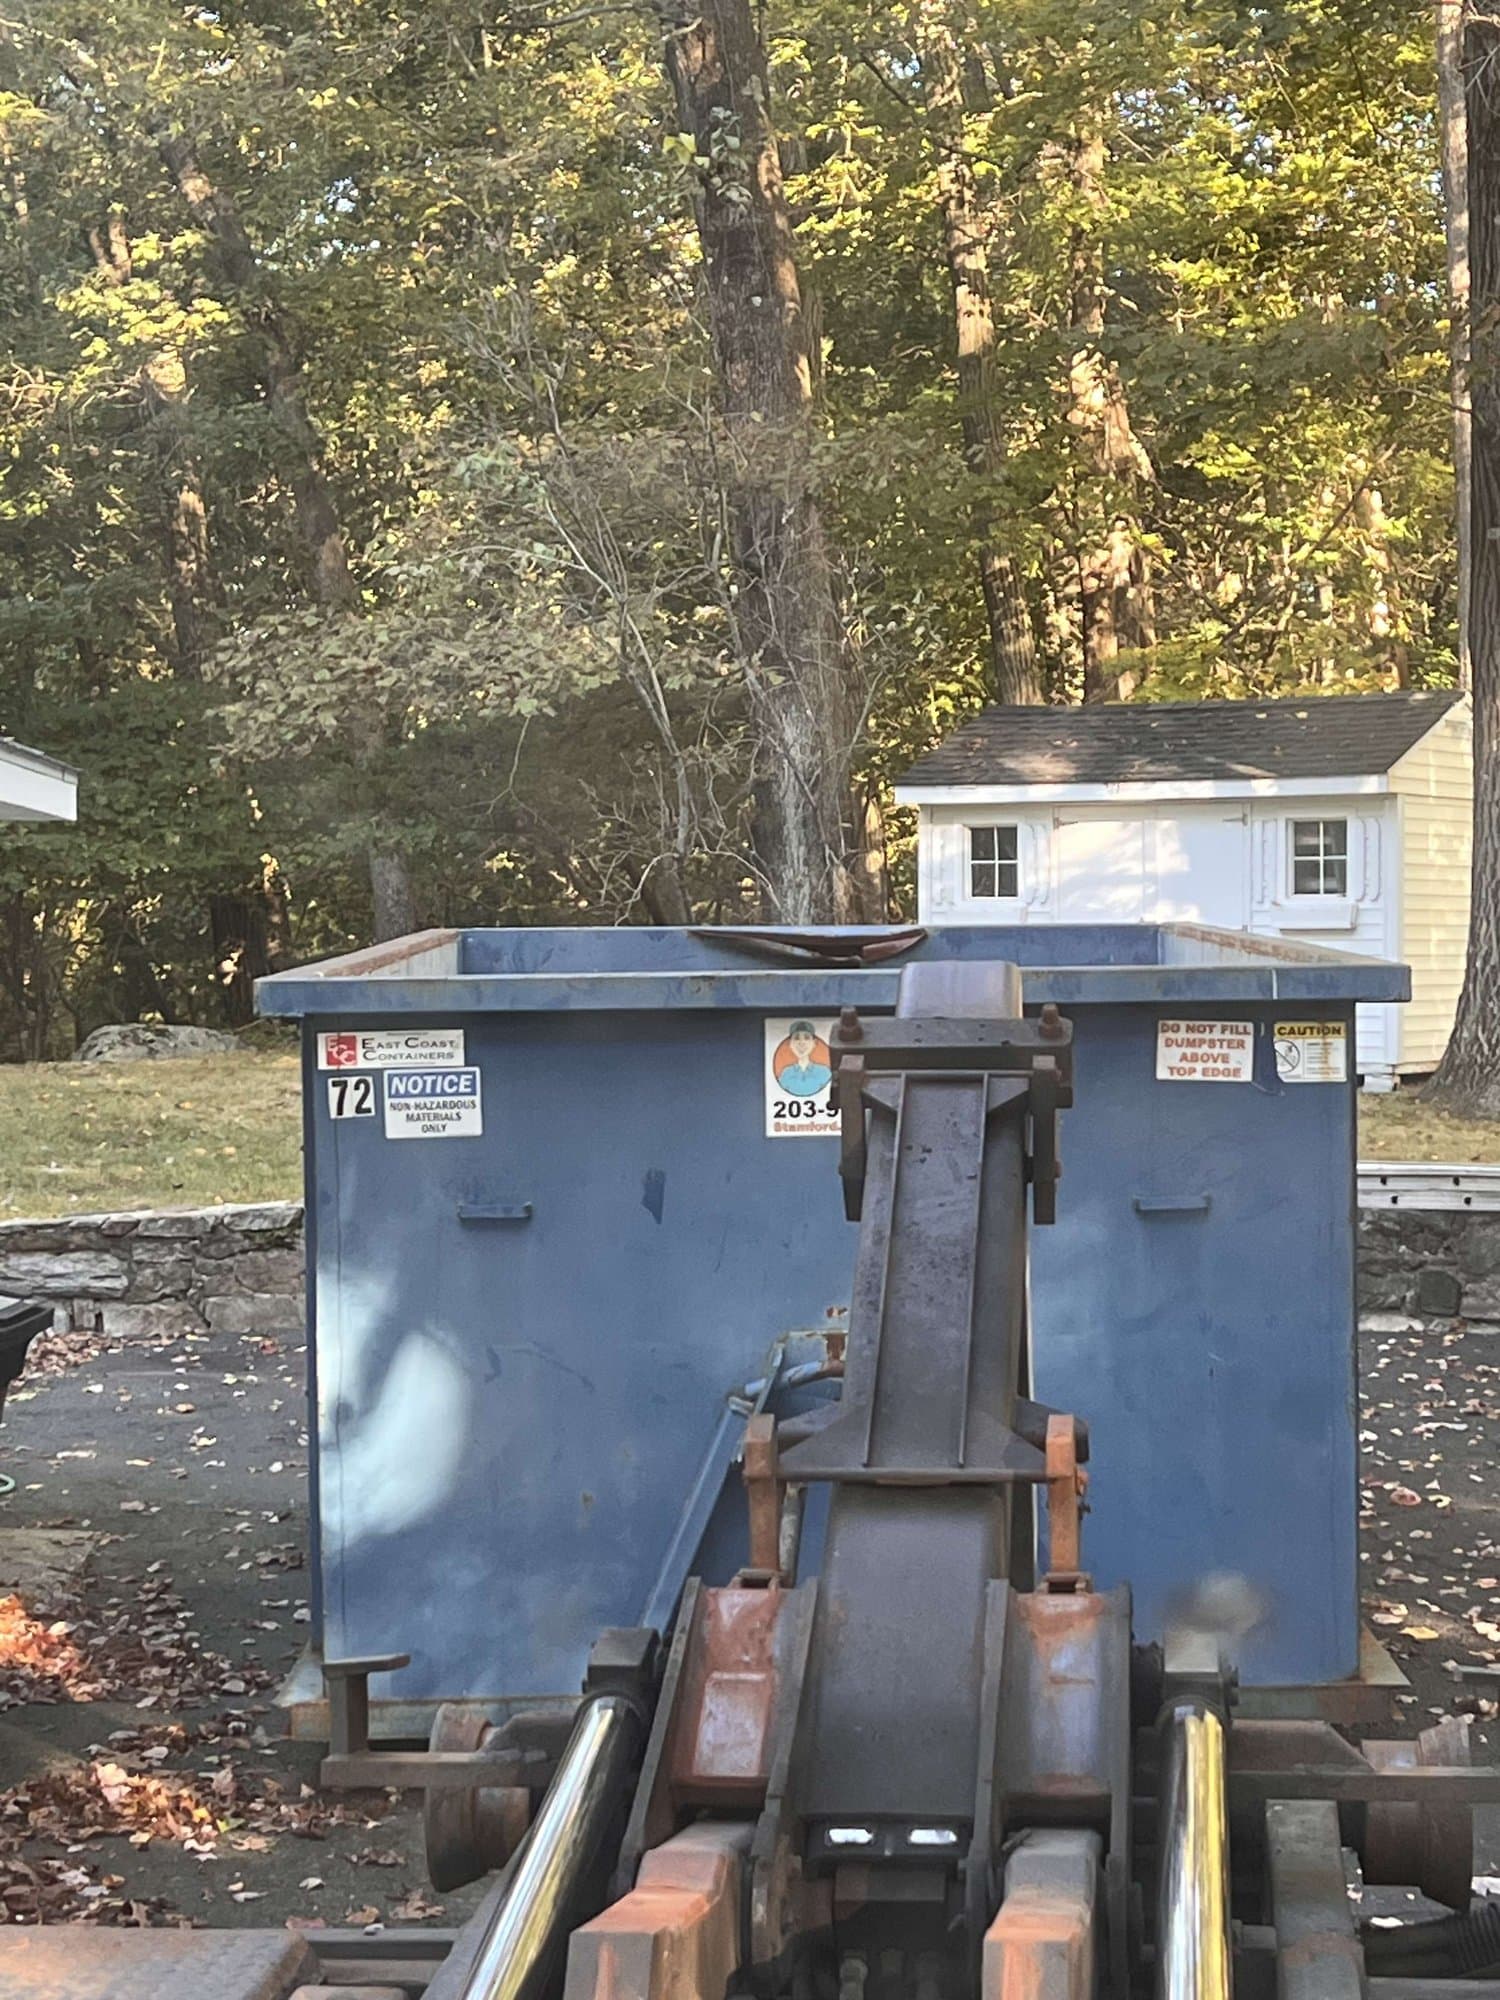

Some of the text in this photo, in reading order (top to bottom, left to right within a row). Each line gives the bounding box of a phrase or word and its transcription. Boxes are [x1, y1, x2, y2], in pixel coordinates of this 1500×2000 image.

[1160, 1023, 1251, 1035] DO NOT FILL
[1276, 1026, 1342, 1036] CAUTION
[361, 1037, 455, 1049] EAST COAST
[1164, 1038, 1245, 1049] DUMPSTER
[362, 1050, 455, 1061] CONTAINERS
[1179, 1053, 1230, 1063] ABOVE
[1168, 1066, 1242, 1077] TOP EDGE
[390, 1074, 473, 1095] NOTICE
[331, 1078, 372, 1116] 72
[406, 1111, 462, 1122] MATERIALS
[421, 1122, 447, 1133] ONLY
